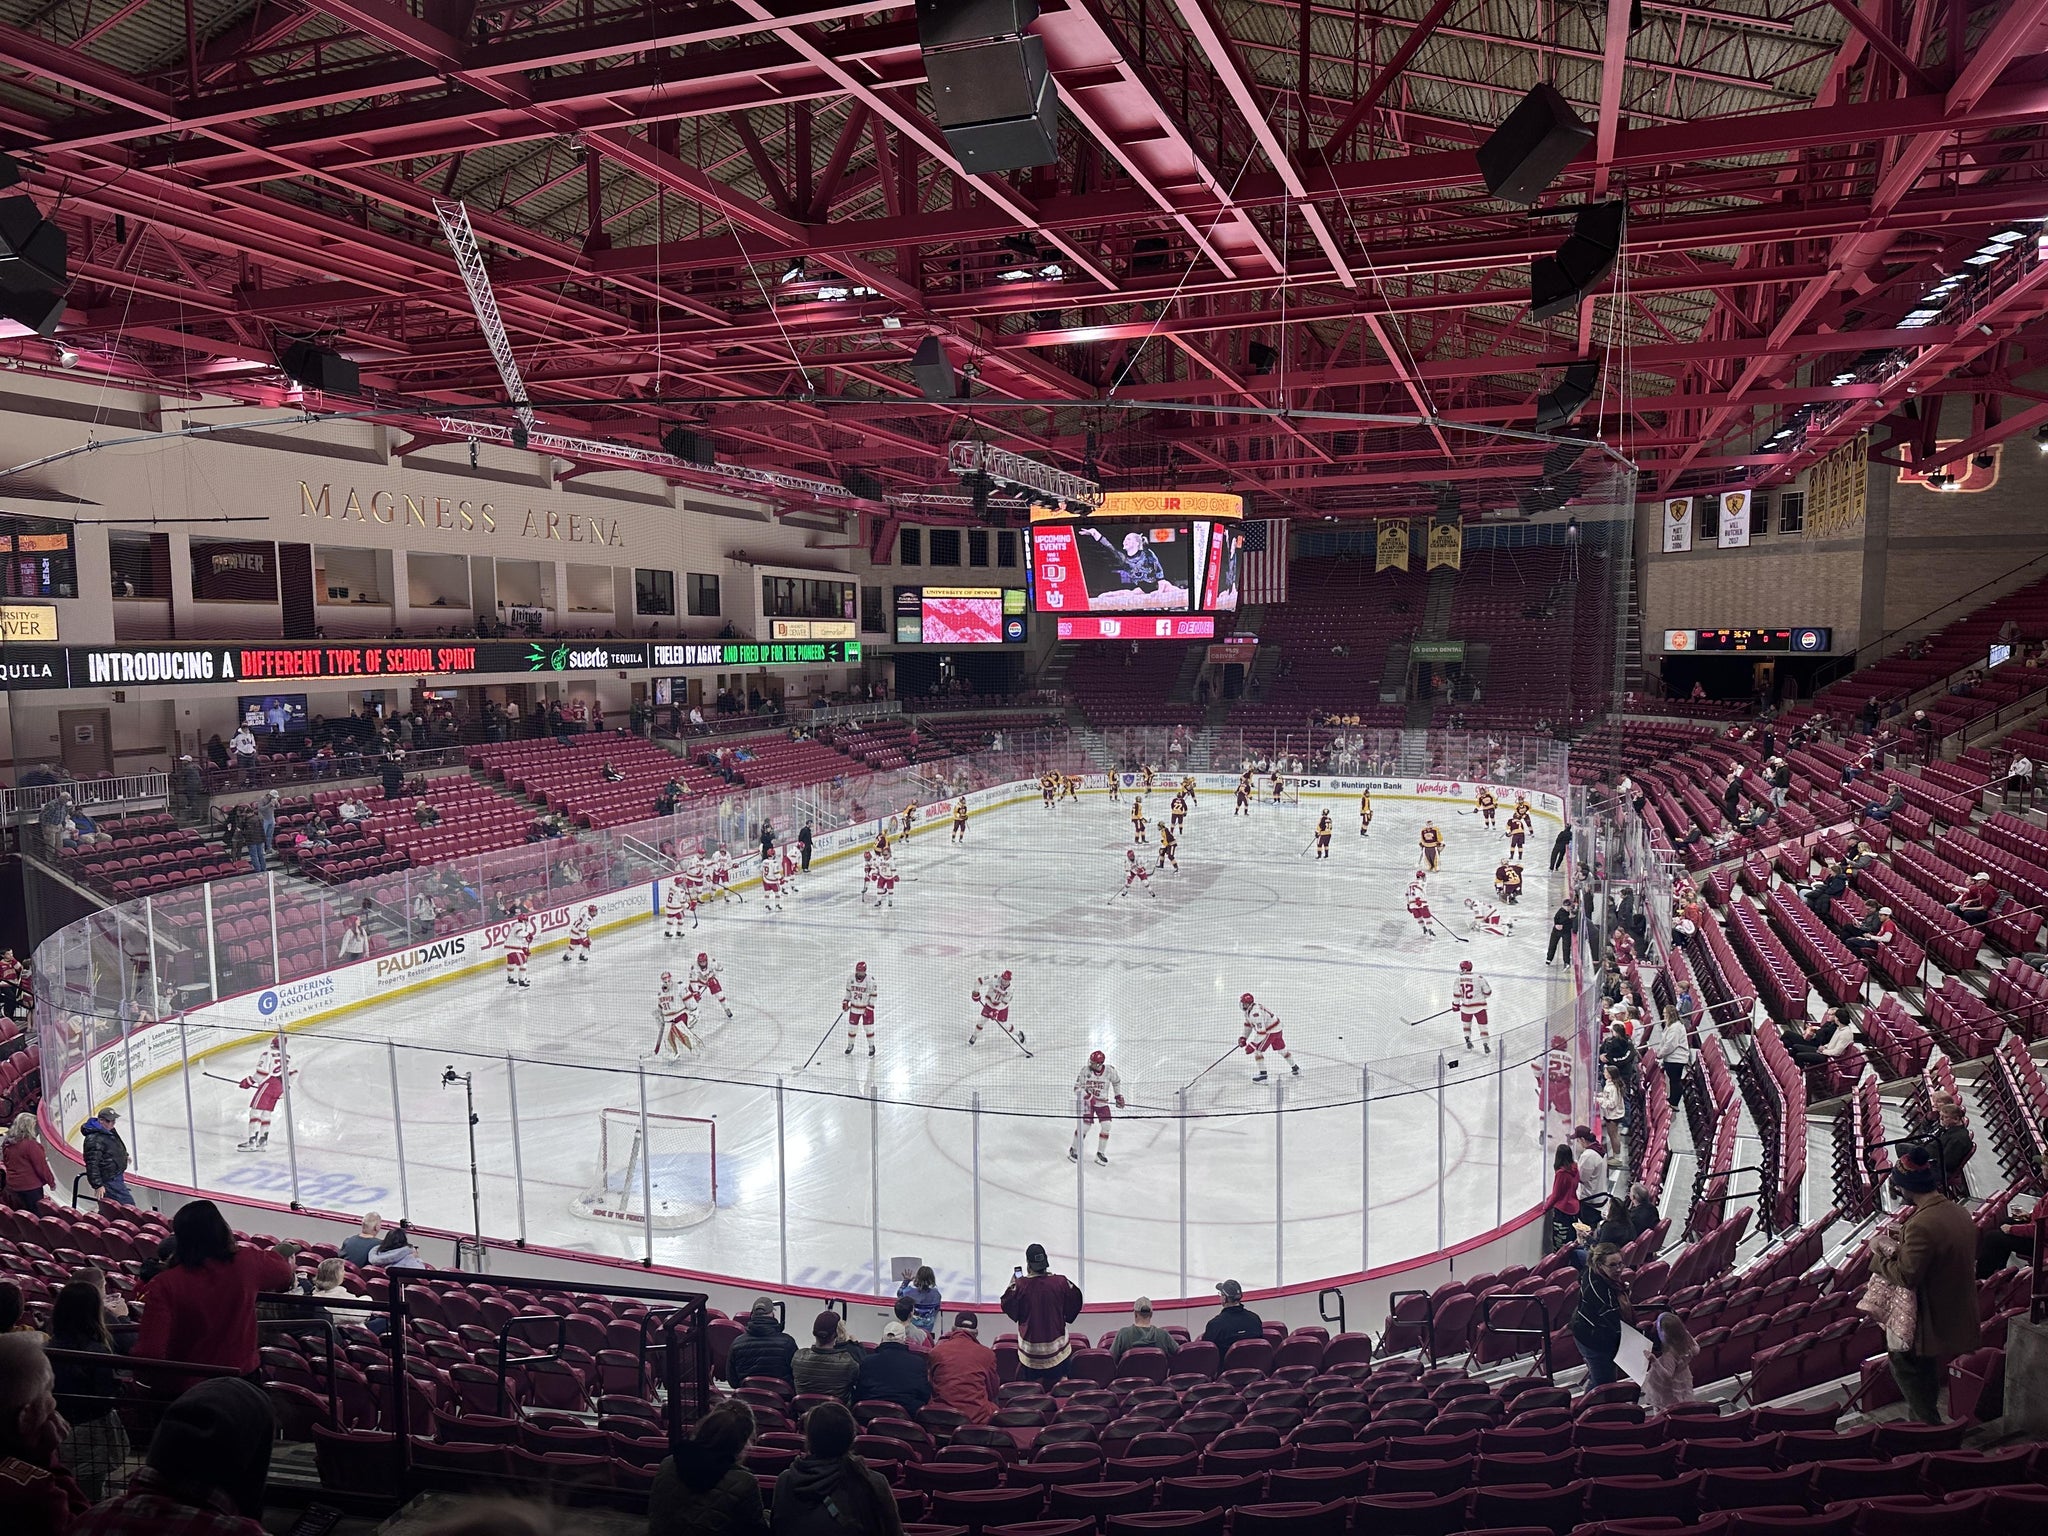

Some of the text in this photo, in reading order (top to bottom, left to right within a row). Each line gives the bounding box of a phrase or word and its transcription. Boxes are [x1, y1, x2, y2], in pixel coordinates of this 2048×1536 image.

[1133, 497, 1180, 510] YOUR
[298, 480, 625, 547] MAGNESS ARENA
[1034, 534, 1071, 544] UPCOMING
[512, 609, 542, 622] Altitude
[569, 647, 643, 668] suerte TEQUILA
[654, 645, 826, 665] FUELED BY AGAVE AND FIRED UP FOR THE PIONEERS
[88, 647, 476, 682] INTRODUCING A DIFFERENT TYPE OF SCHOOL SPIRIT
[1014, 782, 1038, 792] canvas
[1286, 779, 1448, 794] PEPSI Huntington Bank Wendy's
[1174, 802, 1182, 810] 22
[764, 866, 770, 876] 9
[1506, 870, 1520, 881] 33
[607, 894, 647, 912] technology
[667, 894, 672, 903] 6
[541, 908, 570, 933] PLUS
[378, 956, 466, 986] Property Restoration Experts
[280, 984, 335, 1009] ASSOCIATES
[1460, 984, 1474, 1000] 12
[152, 1032, 166, 1040] Learn
[1549, 1060, 1572, 1080] 23
[593, 1209, 606, 1217] HOME
[616, 1212, 624, 1220] THE
